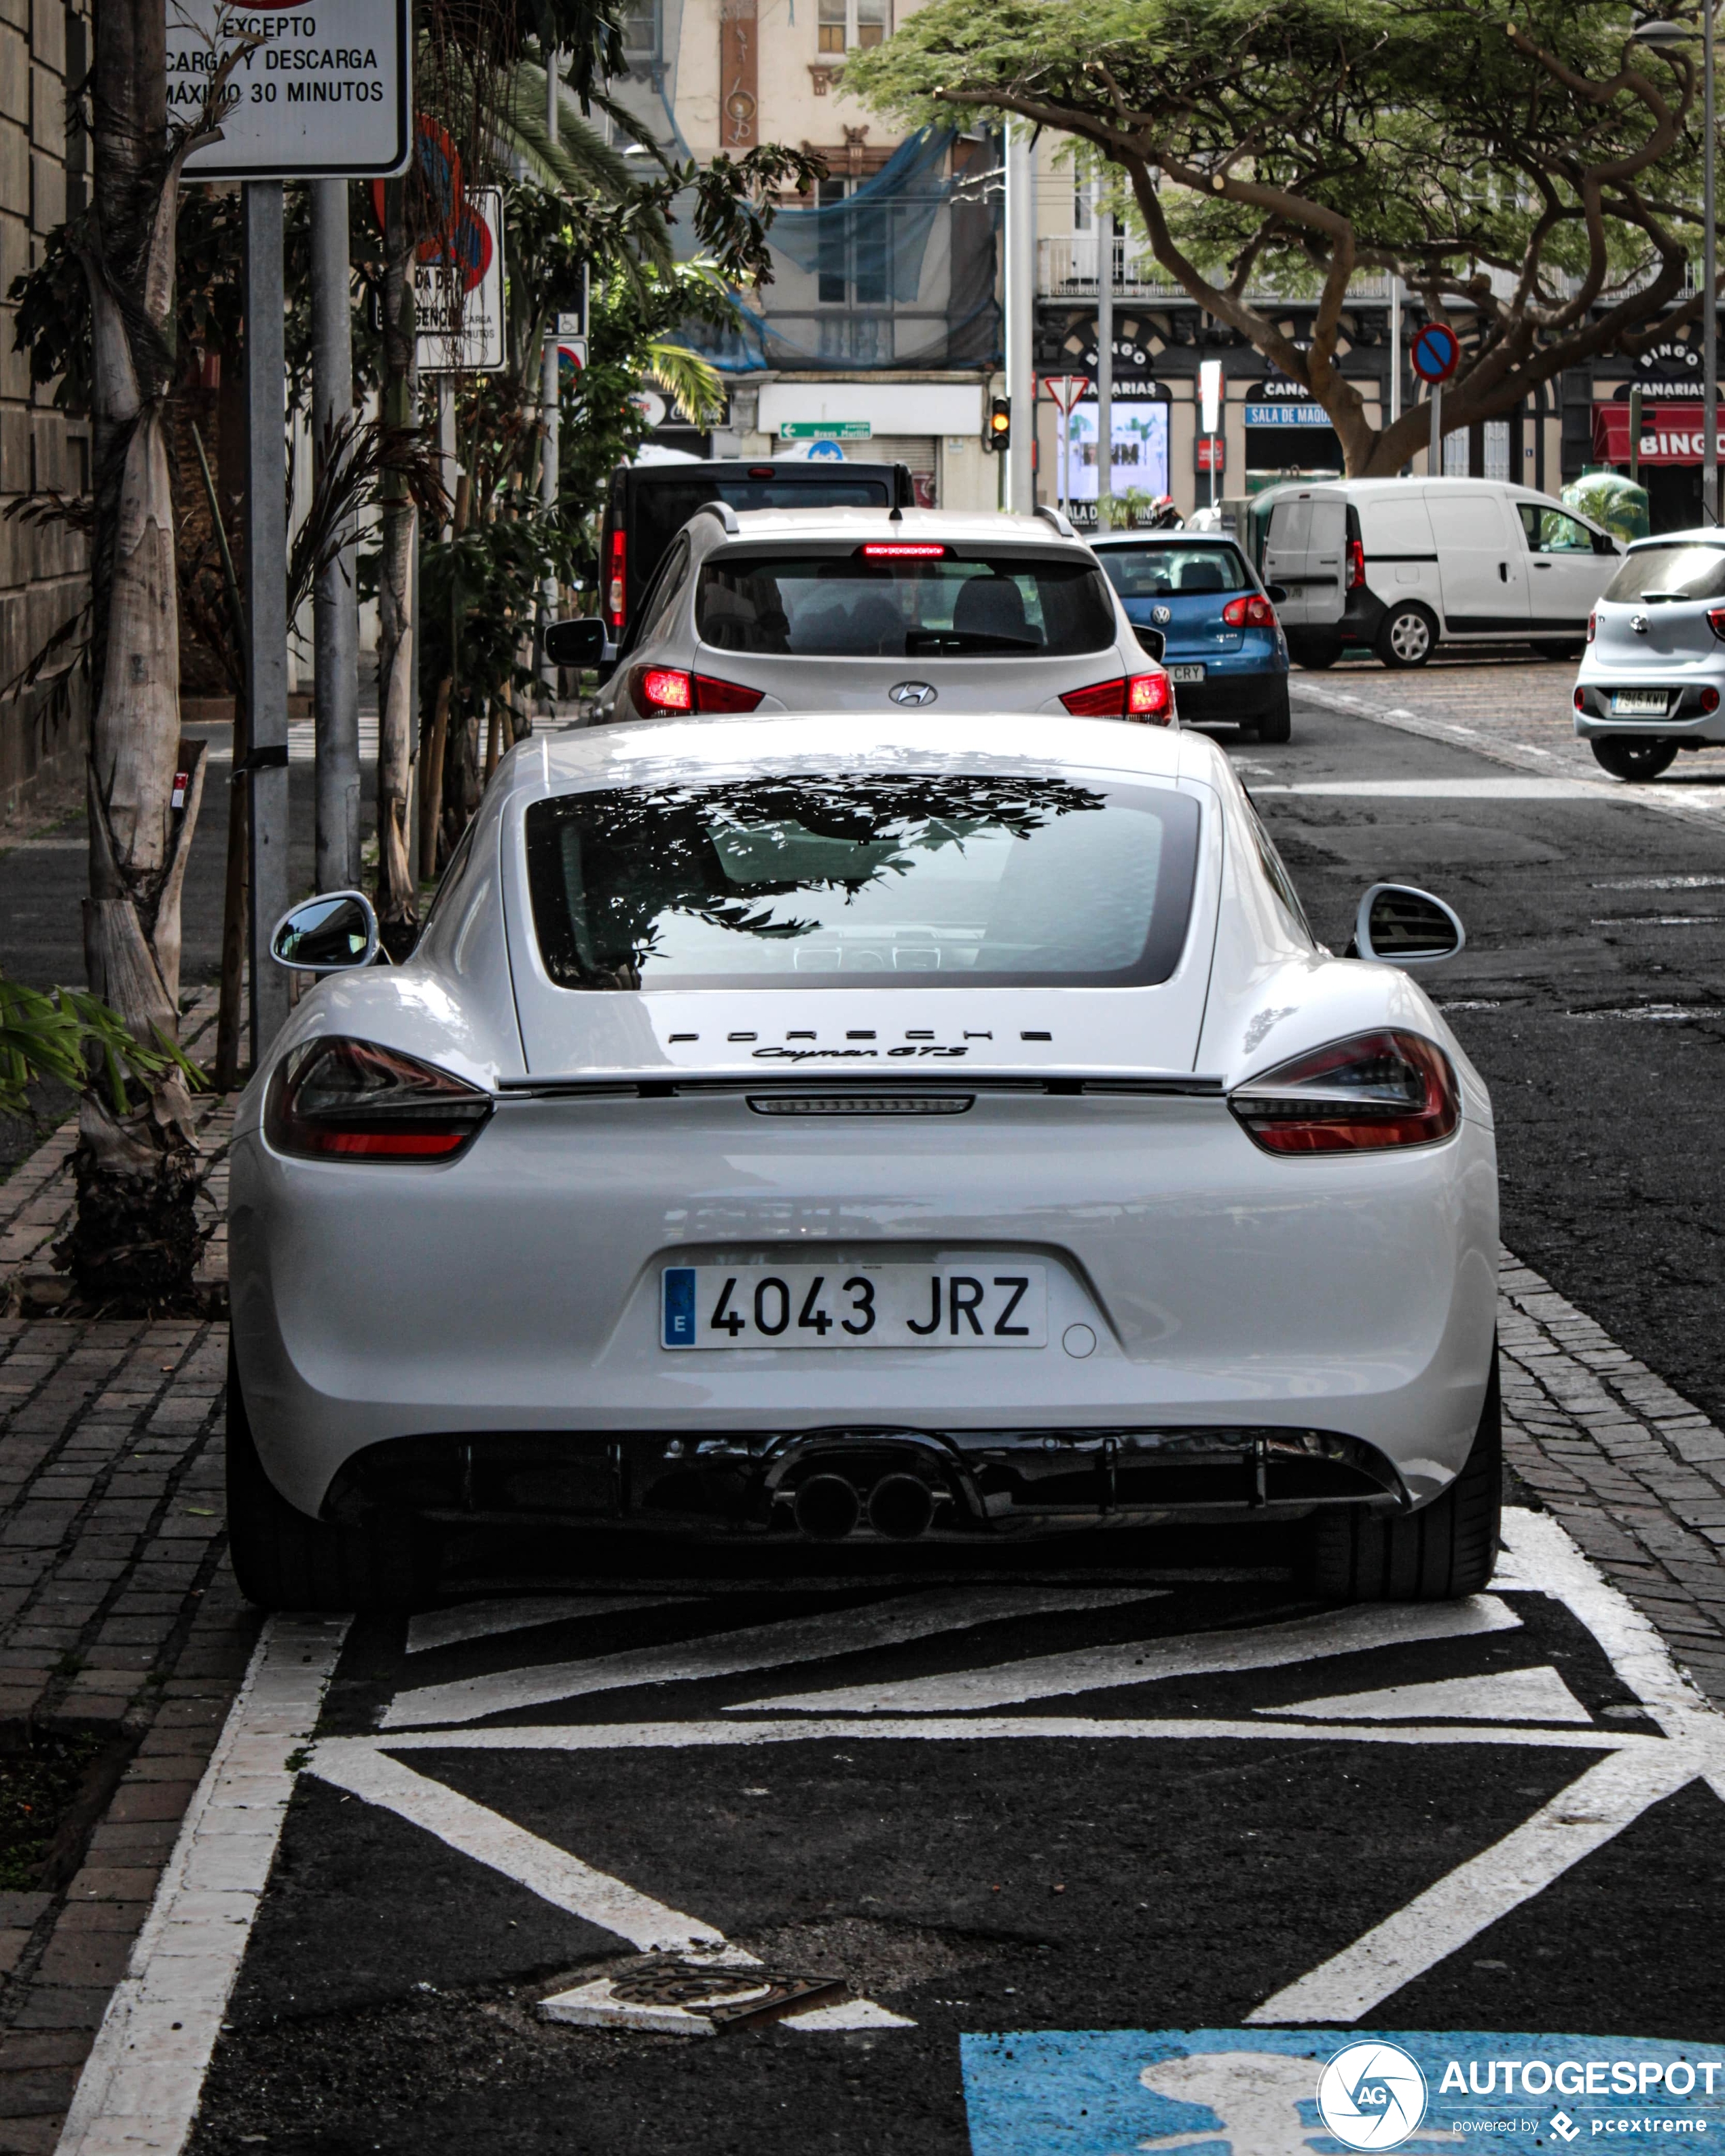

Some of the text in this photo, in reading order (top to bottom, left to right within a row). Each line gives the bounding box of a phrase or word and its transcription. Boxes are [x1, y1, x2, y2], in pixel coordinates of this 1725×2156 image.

[223, 17, 316, 38] EXCEPTO
[166, 49, 378, 72] CARGA Y DESCARGA
[251, 83, 276, 103] 30
[287, 81, 384, 102] MINUTOS
[1085, 342, 1146, 366] BNGO
[1640, 344, 1698, 367] BINGO
[1265, 382, 1309, 396] CANA
[1252, 407, 1330, 423] SALA DE MAQU
[814, 430, 837, 439] Bravo
[669, 1030, 1052, 1043] PORSCHE
[752, 1046, 968, 1062] Cayman GTS
[710, 1276, 1030, 1337] 4043 JRZ
[674, 1315, 686, 1332] E
